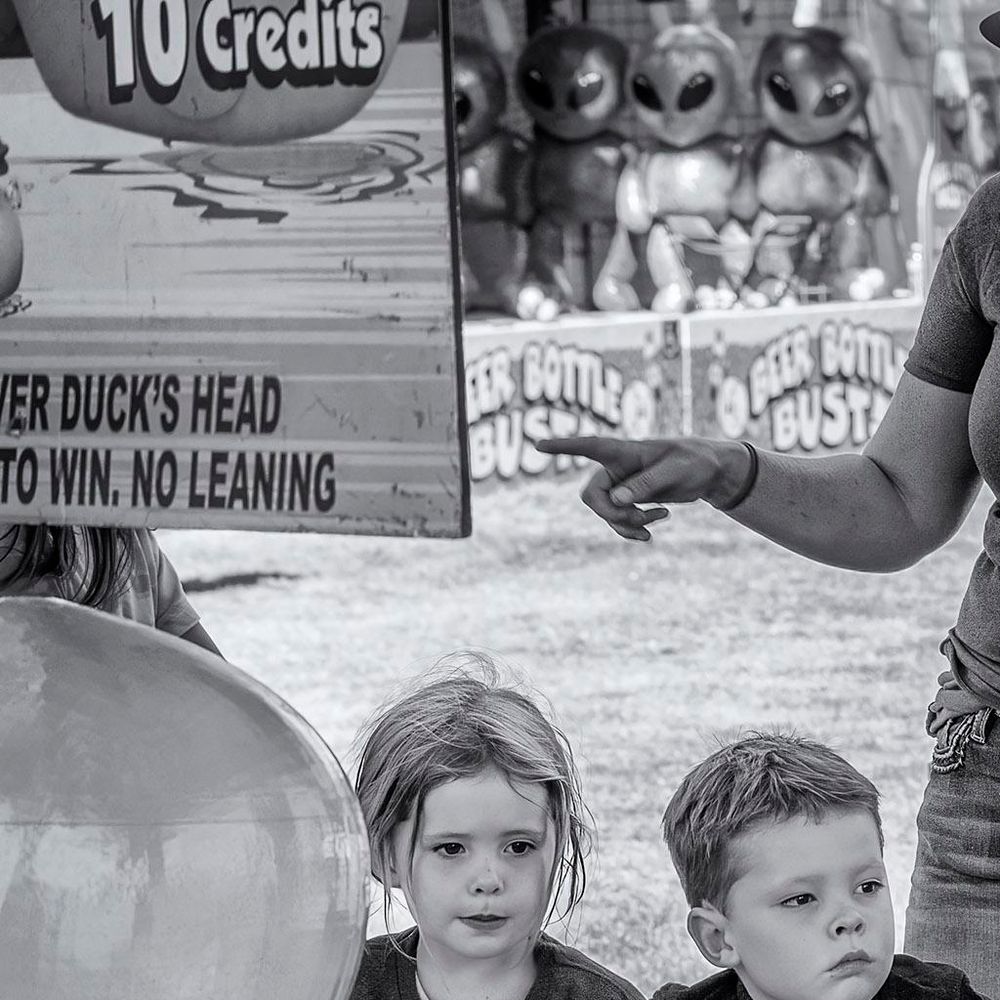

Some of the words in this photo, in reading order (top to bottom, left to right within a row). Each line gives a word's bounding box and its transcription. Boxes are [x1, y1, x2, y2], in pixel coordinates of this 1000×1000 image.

[92, 0, 188, 104] 10
[197, 0, 385, 91] Credits
[523, 340, 622, 427] BOTTLE
[820, 319, 909, 395] BOTTL
[60, 374, 180, 433] DUCK'S
[191, 375, 282, 434] HEAD
[0, 447, 38, 505] TO
[50, 448, 119, 507] WIN.
[131, 450, 178, 508] NO
[188, 451, 337, 512] LEANING
